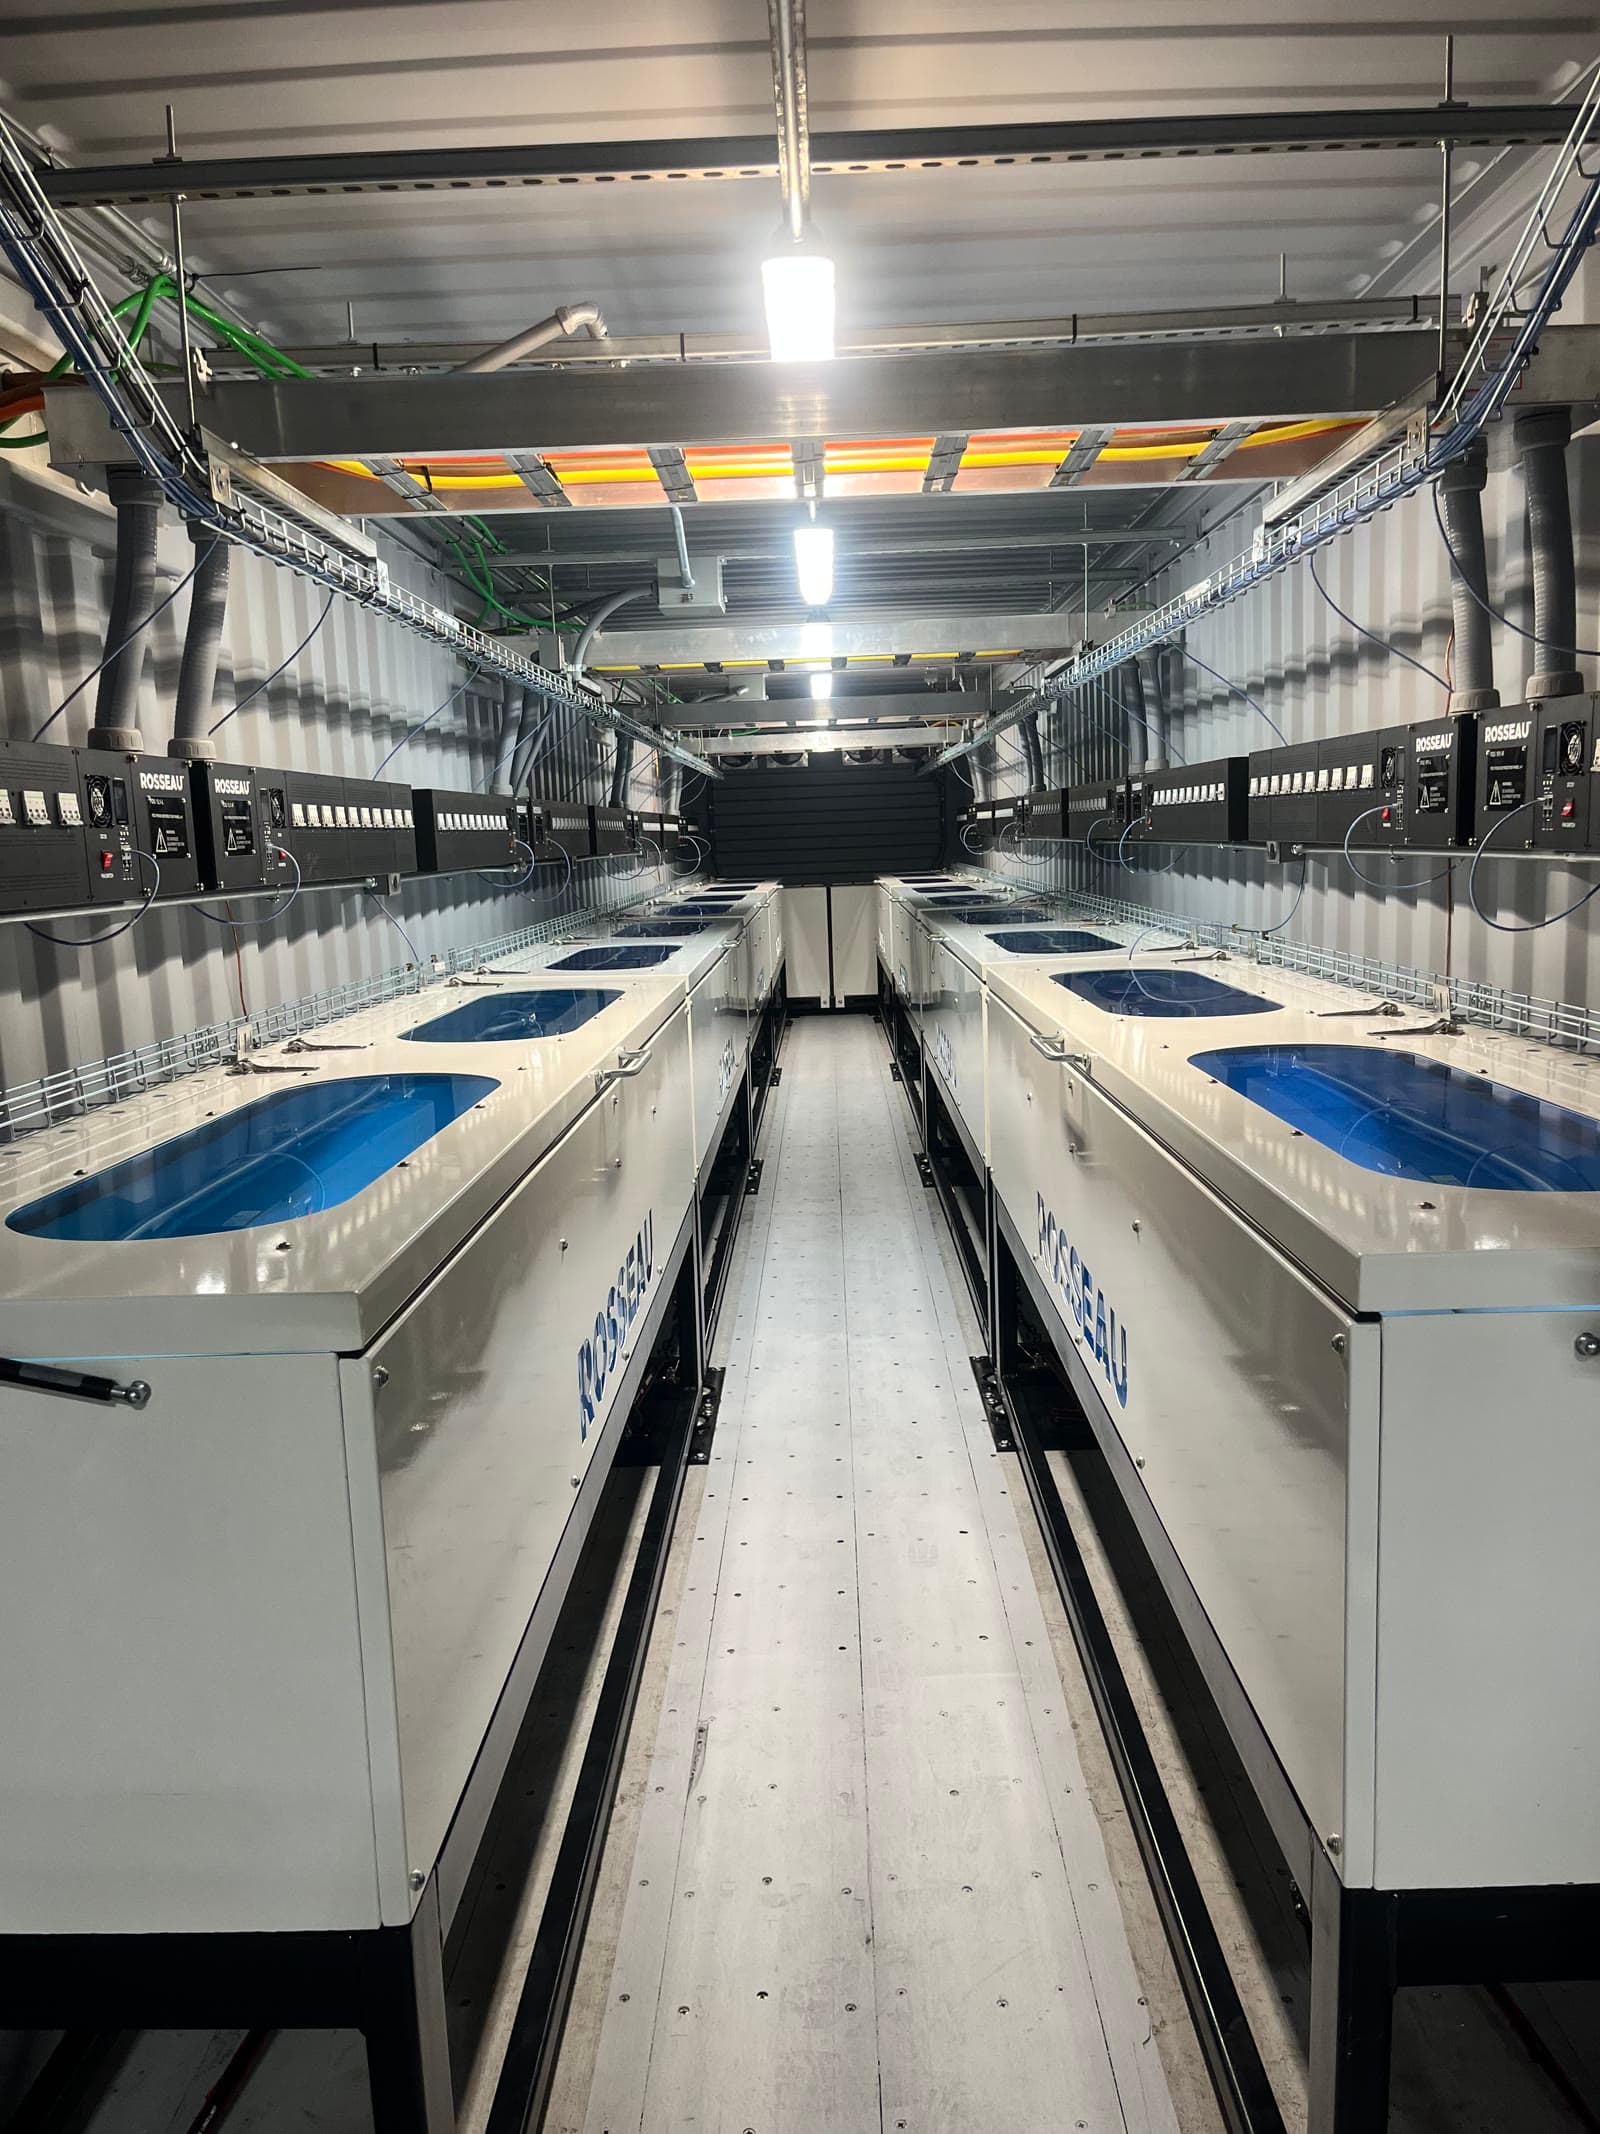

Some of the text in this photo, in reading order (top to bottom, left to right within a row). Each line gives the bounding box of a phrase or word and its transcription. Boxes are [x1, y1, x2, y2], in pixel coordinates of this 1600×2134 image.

[1484, 721, 1532, 743] ROSSEAU
[1415, 733, 1454, 753] ROSSEAU
[139, 772, 185, 791] ROSSEAU
[214, 778, 251, 795] ROSSEAU
[1037, 1190, 1127, 1409] ROSSEAU
[577, 1208, 653, 1445] ROSSEAU
